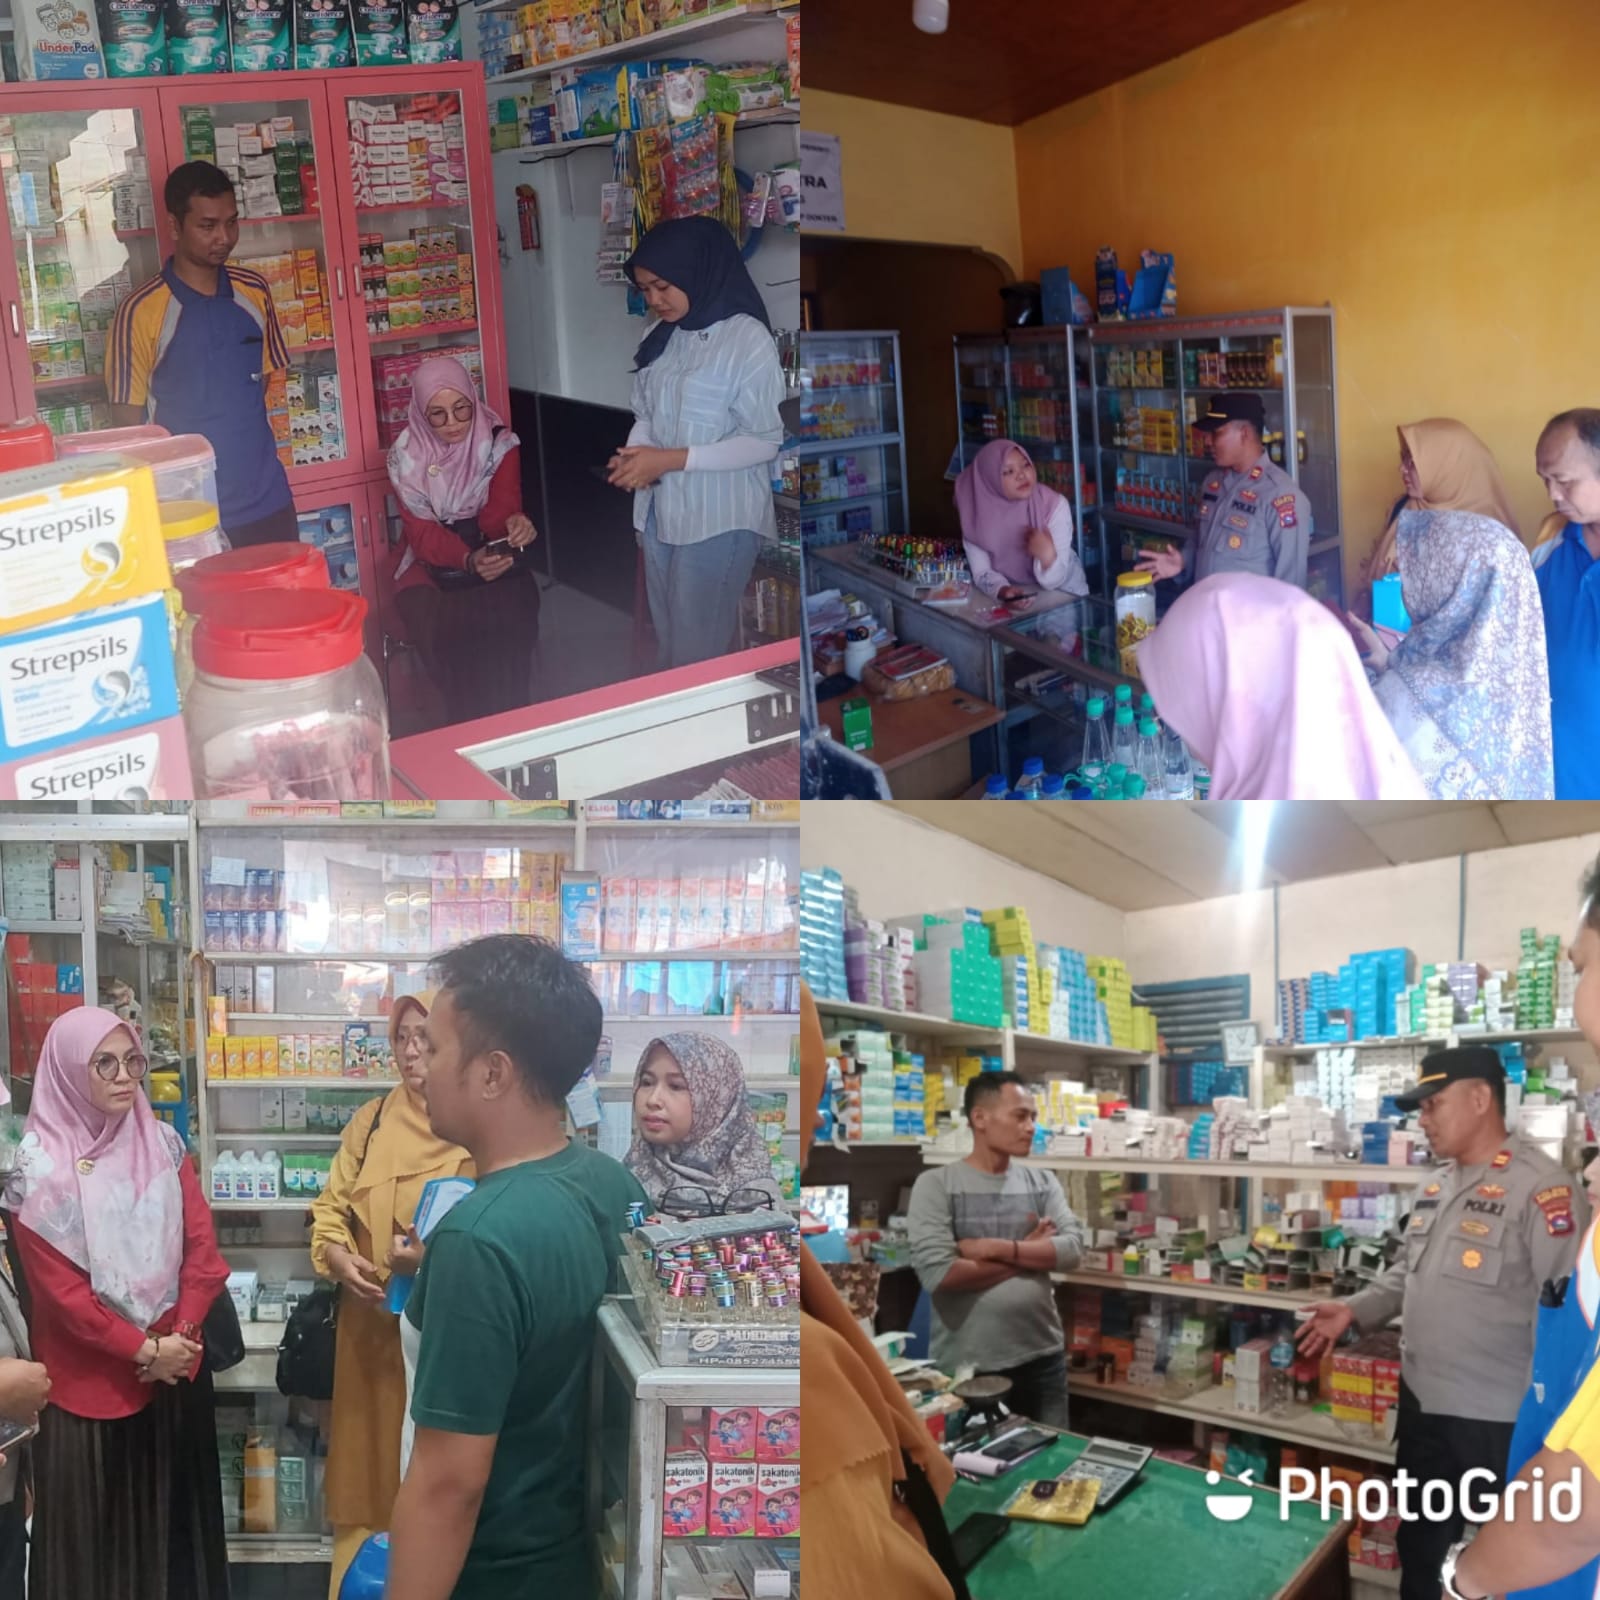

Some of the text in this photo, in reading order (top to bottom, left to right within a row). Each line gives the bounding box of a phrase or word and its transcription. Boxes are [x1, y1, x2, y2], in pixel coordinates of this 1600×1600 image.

[0, 506, 115, 550] Strepsils
[10, 636, 128, 680] Strepsils
[30, 753, 145, 799] Strepsils
[1463, 1200, 1506, 1216] POLRI
[665, 1466, 704, 1477] sakatonik
[715, 1466, 754, 1477] sakatonik
